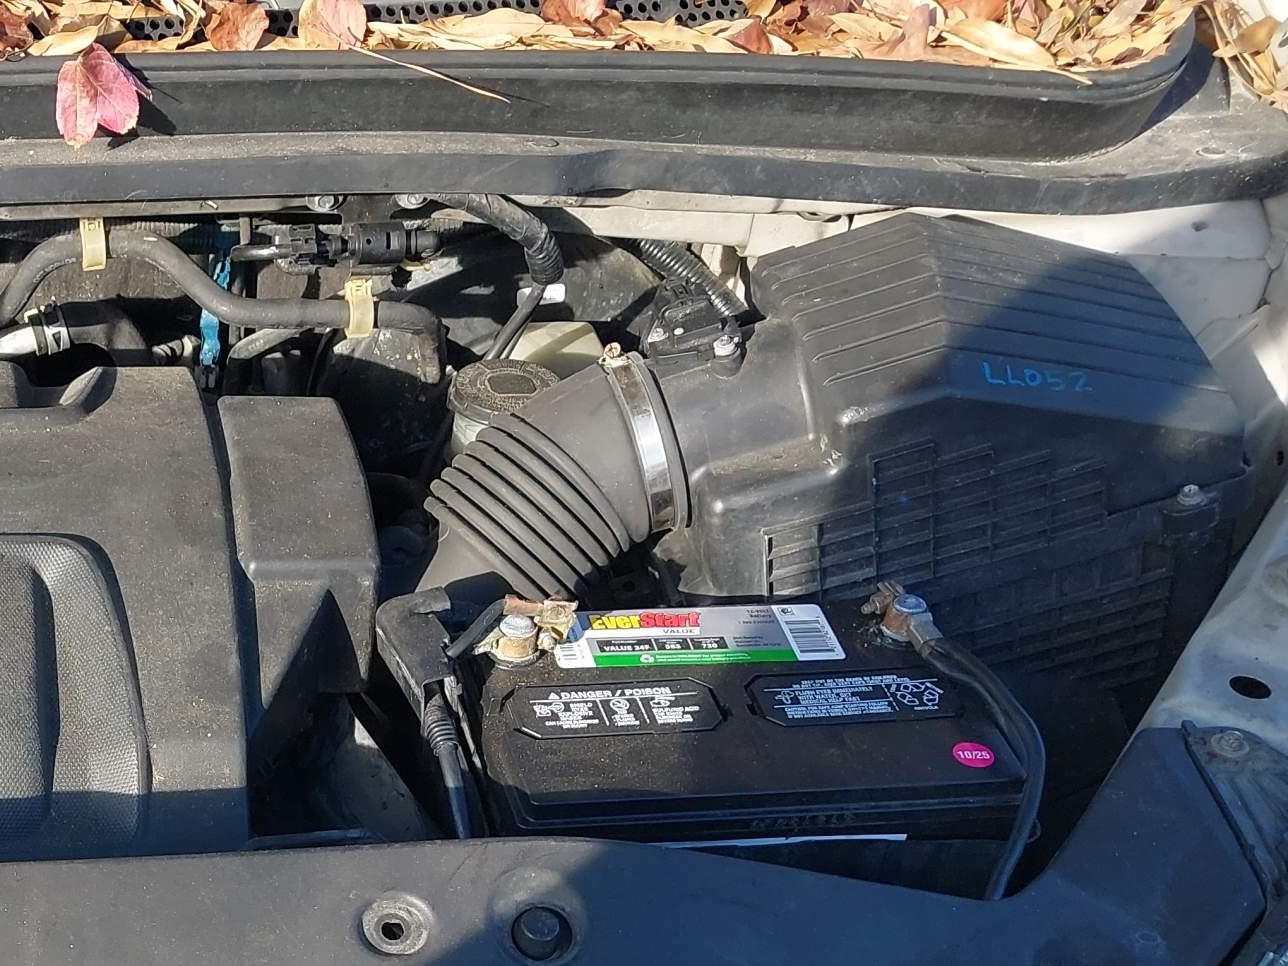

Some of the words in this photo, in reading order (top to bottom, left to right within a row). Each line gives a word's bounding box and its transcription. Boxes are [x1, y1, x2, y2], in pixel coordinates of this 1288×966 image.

[589, 611, 701, 631] EverStart
[560, 689, 613, 700] DANGER
[624, 686, 673, 697] POISON
[956, 750, 991, 760] 10/25
